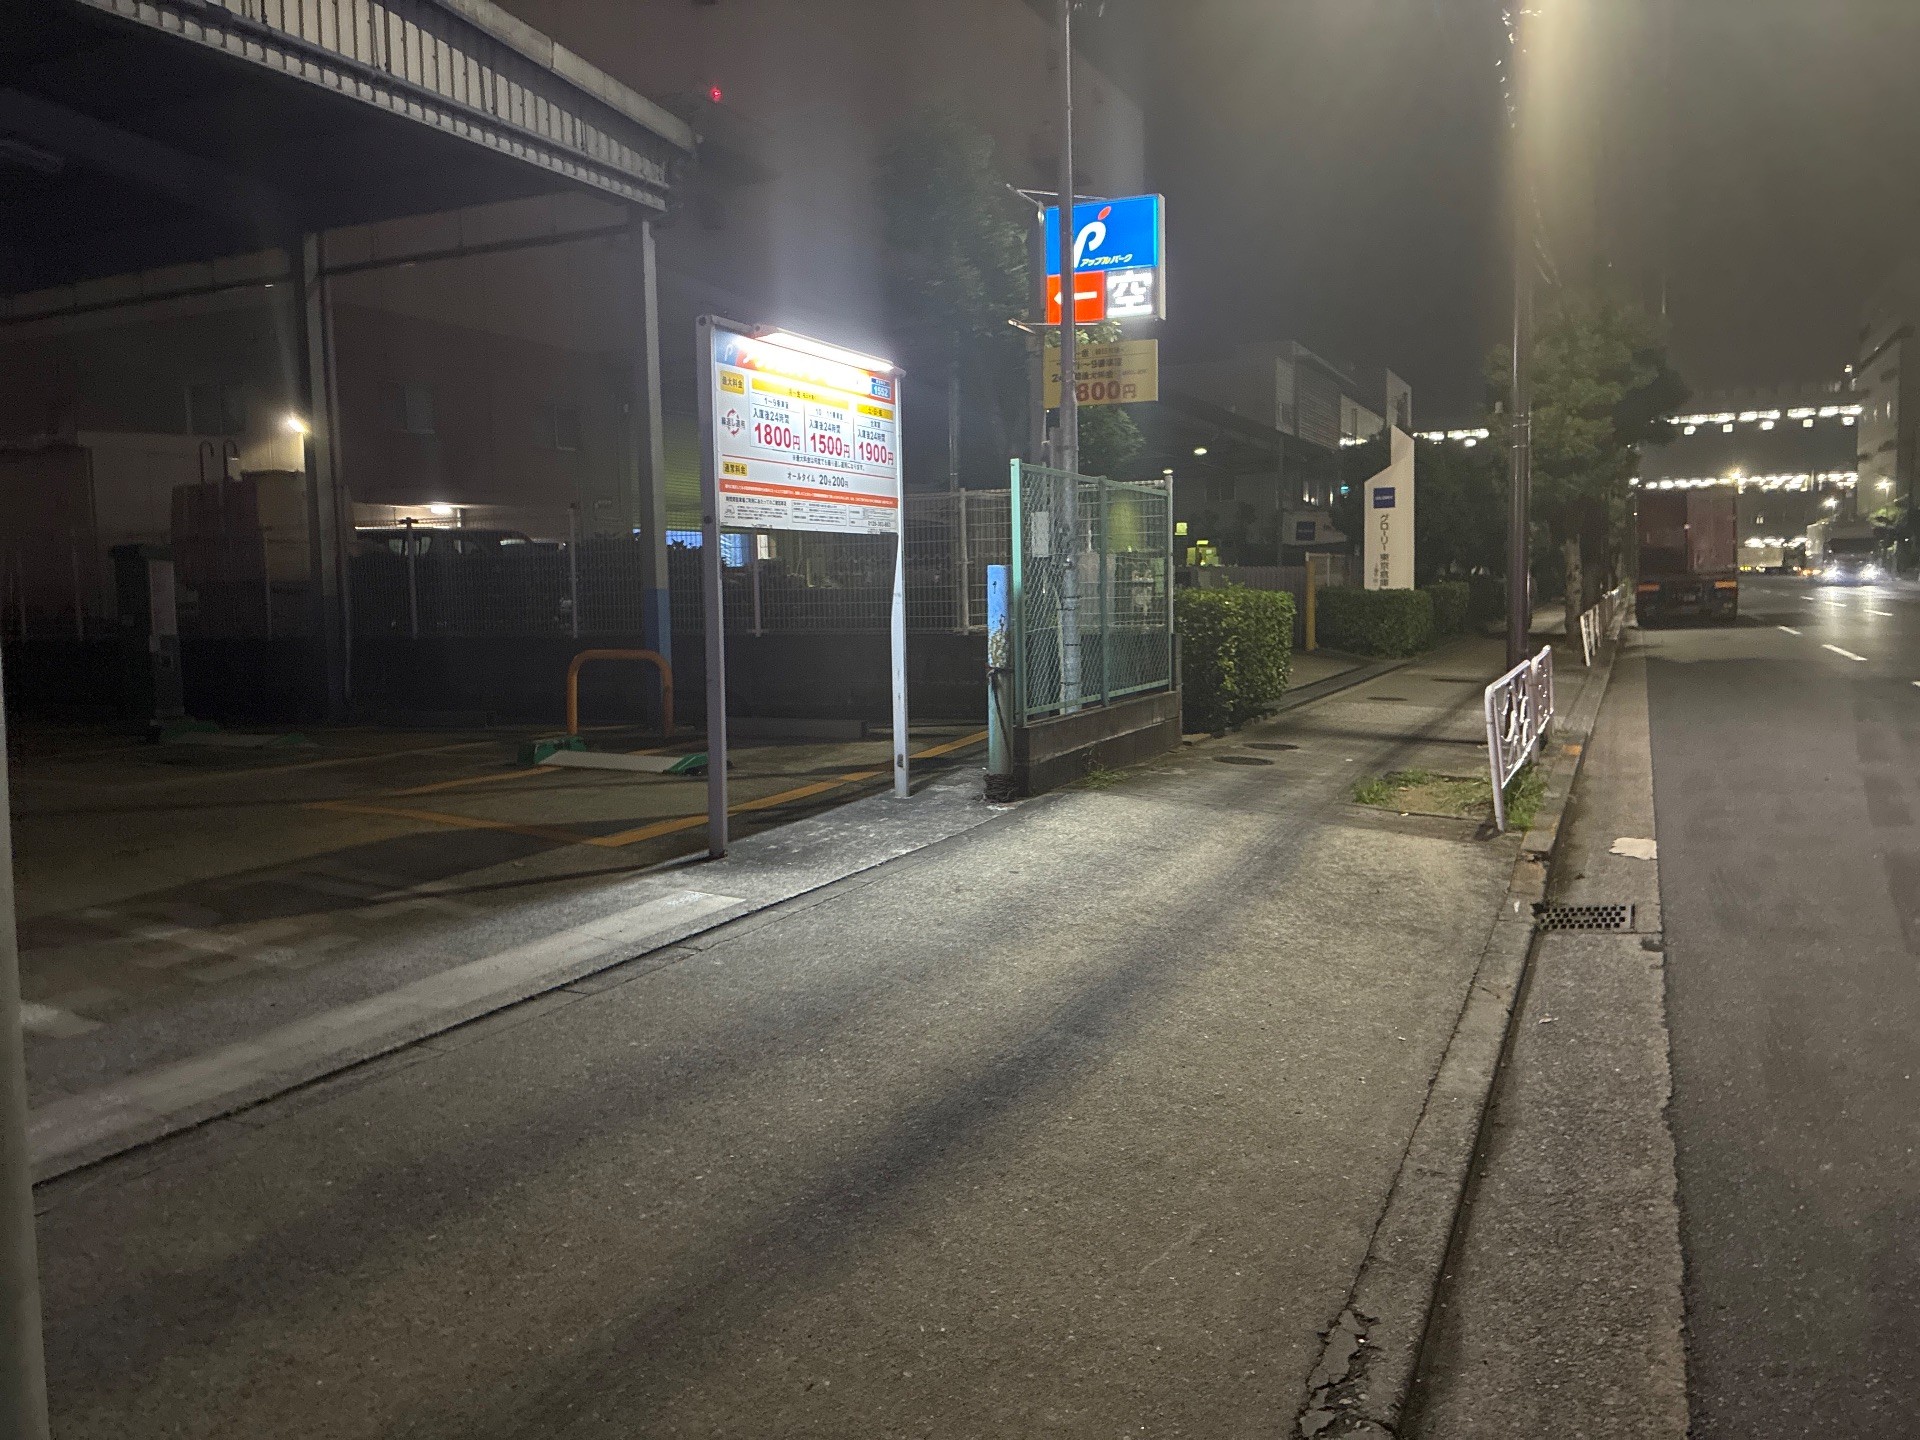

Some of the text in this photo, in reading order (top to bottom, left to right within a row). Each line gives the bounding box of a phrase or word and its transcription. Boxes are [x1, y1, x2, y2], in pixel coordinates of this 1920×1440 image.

[1107, 270, 1152, 318] 空
[755, 422, 800, 450] 1800円
[810, 432, 850, 459] 1500円
[858, 441, 894, 466] 1900円
[787, 471, 815, 482] オールタイム
